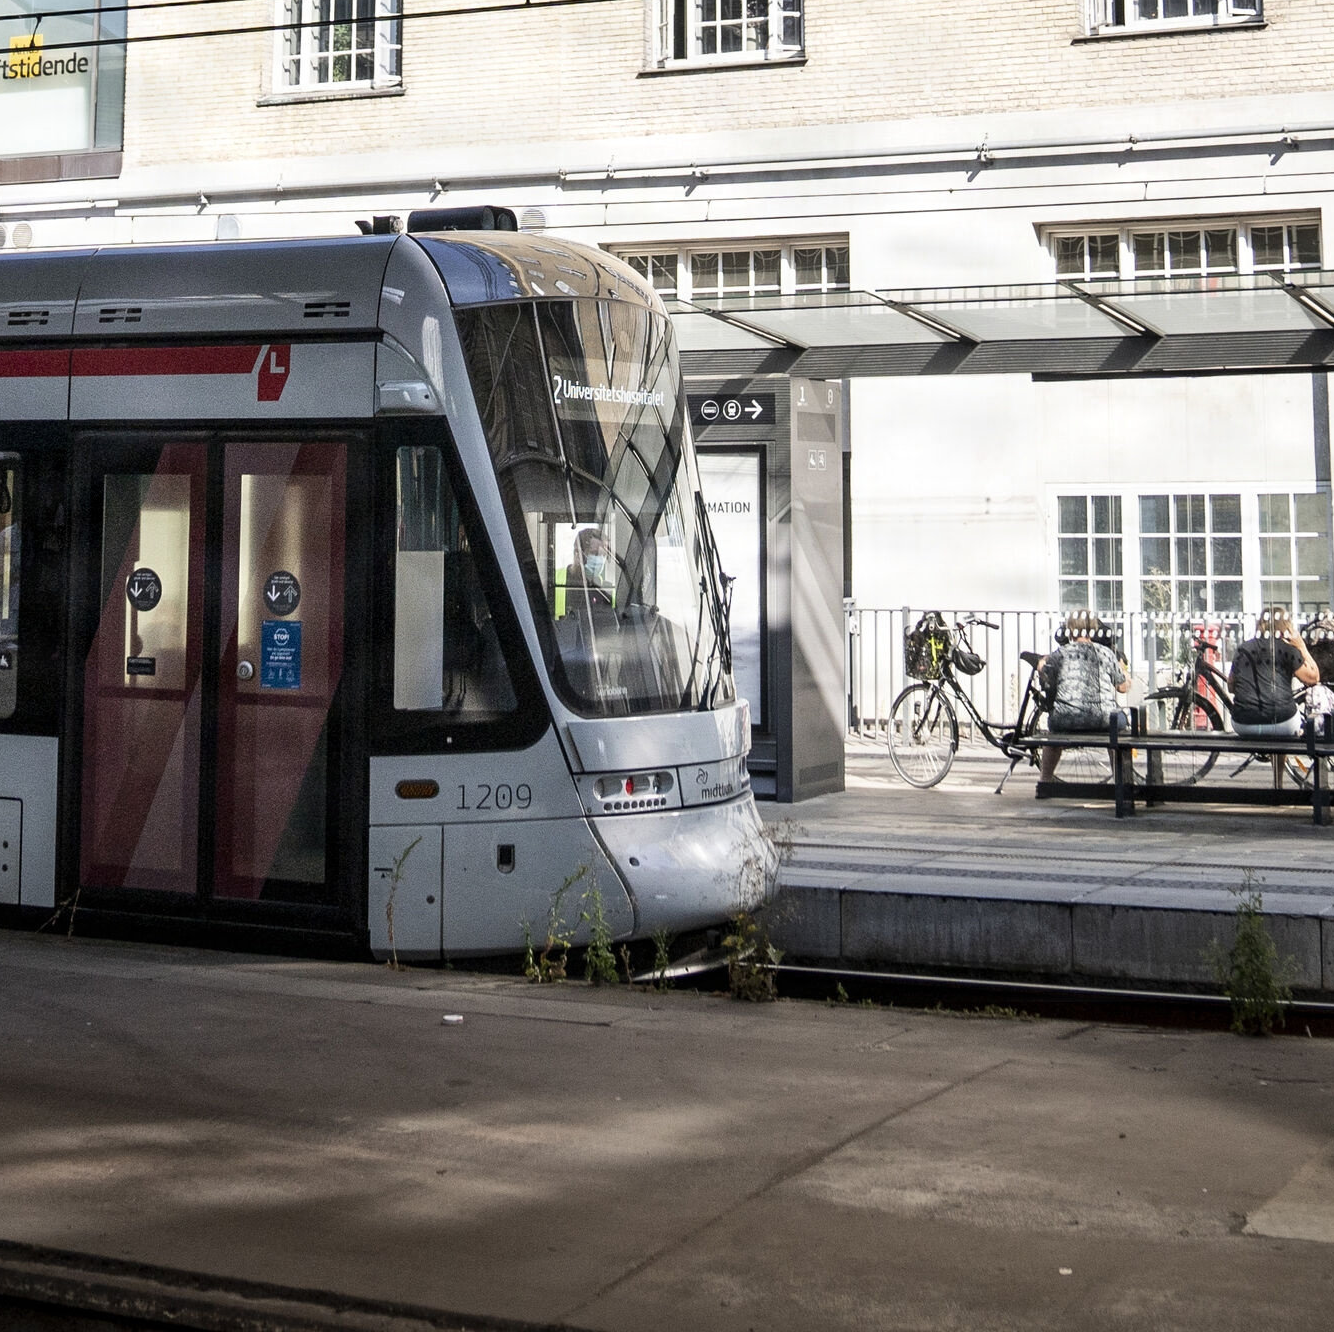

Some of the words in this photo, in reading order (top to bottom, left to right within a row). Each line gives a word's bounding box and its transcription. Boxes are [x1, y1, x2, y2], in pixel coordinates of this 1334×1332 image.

[564, 379, 665, 406] Universitetshospitalet
[707, 501, 751, 514] MATION
[456, 783, 532, 810] 1209
